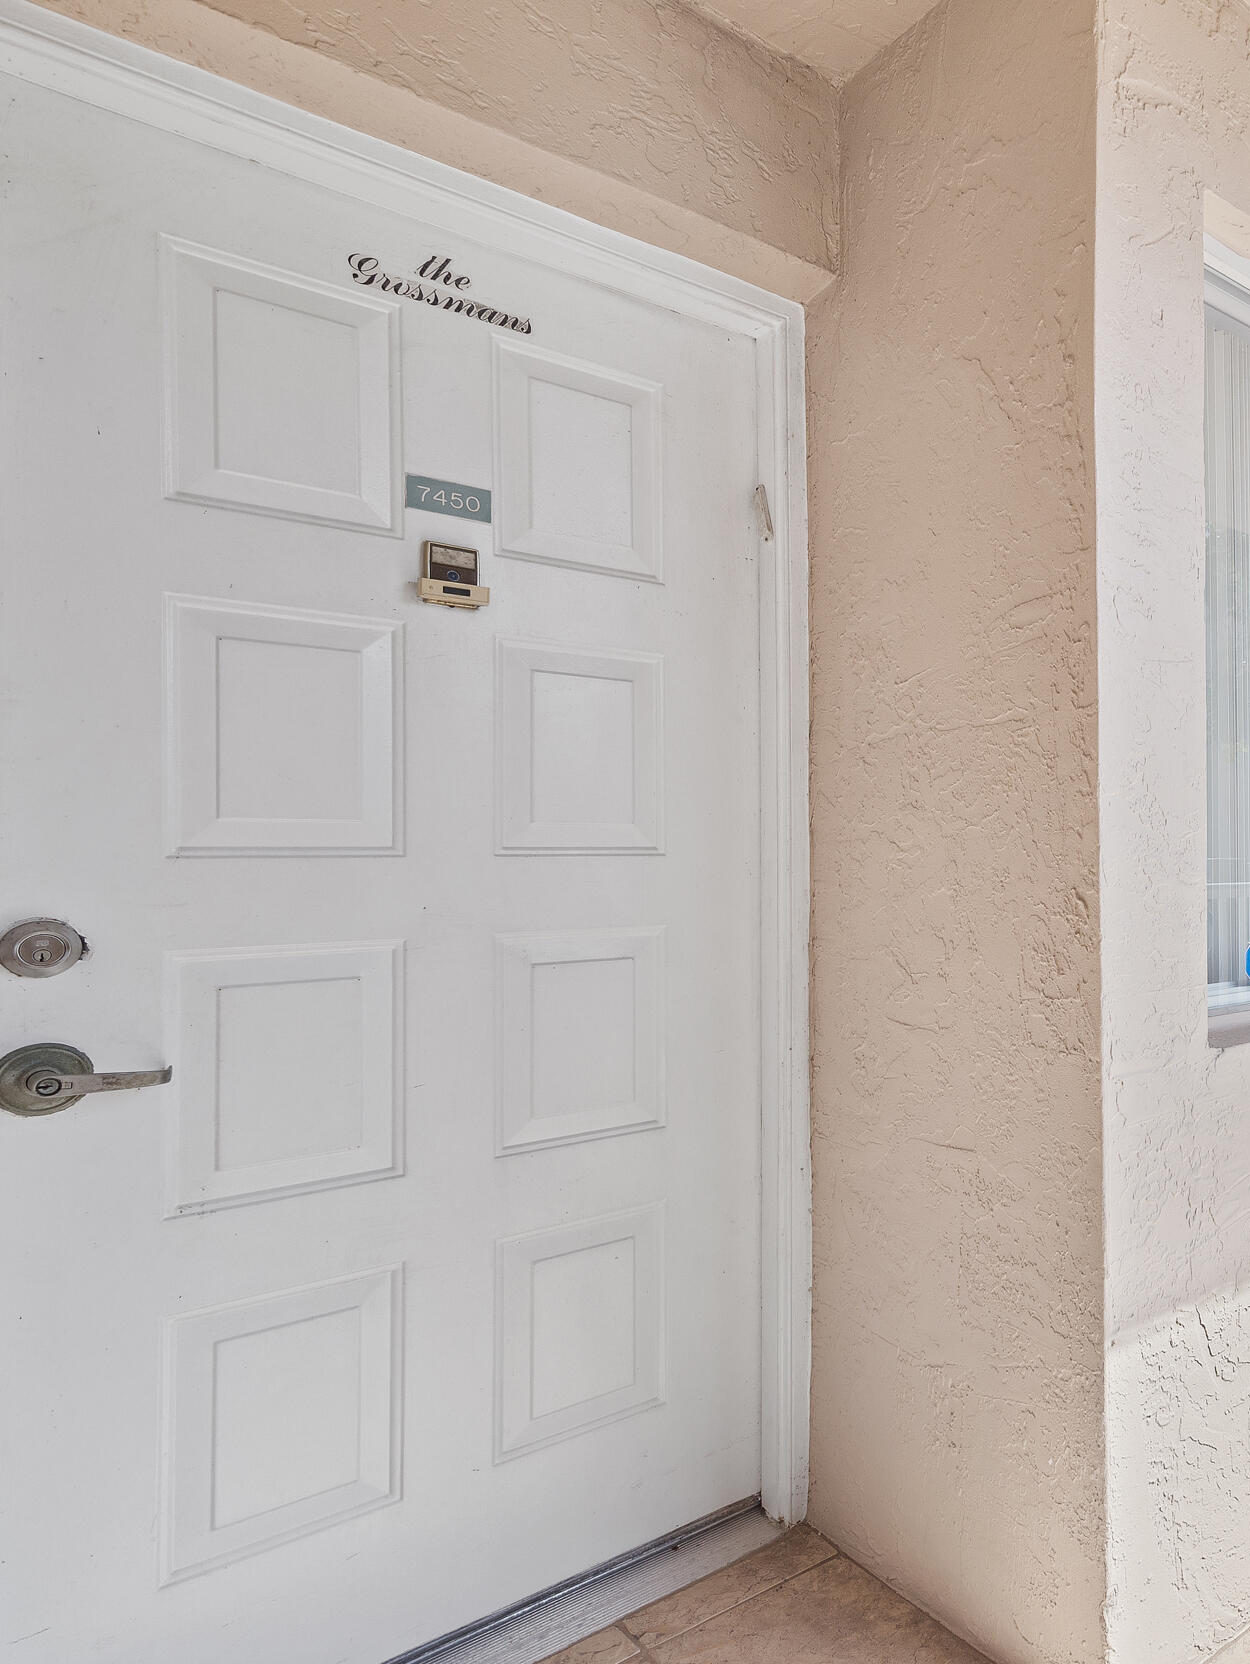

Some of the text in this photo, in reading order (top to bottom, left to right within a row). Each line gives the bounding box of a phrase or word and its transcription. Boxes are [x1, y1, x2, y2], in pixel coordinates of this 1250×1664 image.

[415, 255, 471, 290] the
[348, 253, 532, 334] Grossmans
[417, 485, 480, 512] 7450
